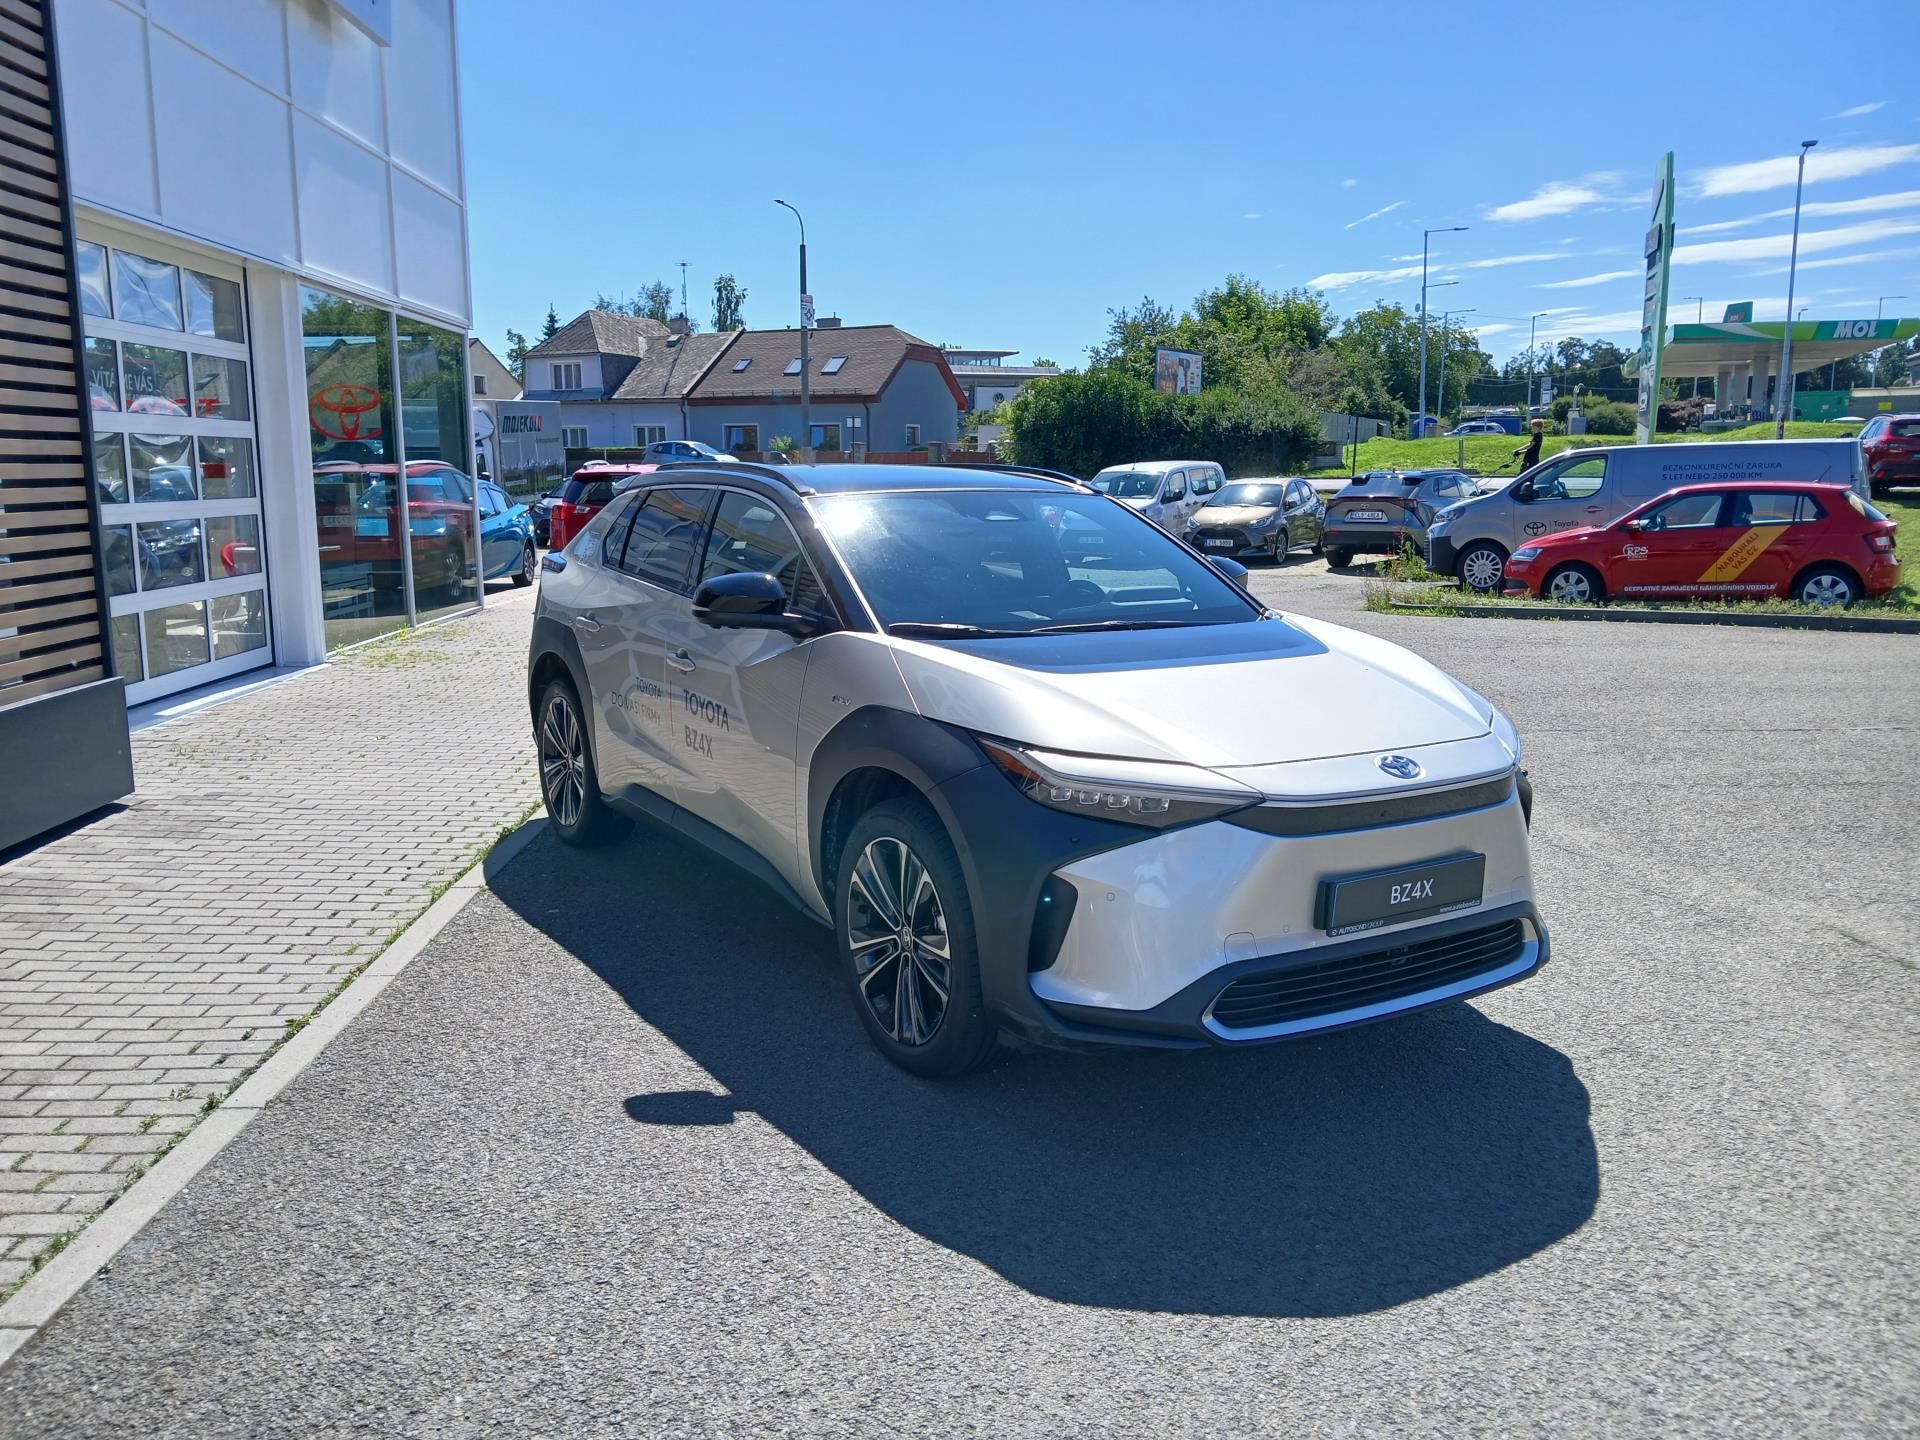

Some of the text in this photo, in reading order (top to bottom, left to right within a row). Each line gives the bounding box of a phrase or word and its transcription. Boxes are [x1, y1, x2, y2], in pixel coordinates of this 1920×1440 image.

[1833, 321, 1878, 338] MOL
[1685, 472, 1710, 480] NEBO
[1748, 471, 1762, 479] KM
[1553, 520, 1579, 528] Toyota
[1625, 545, 1648, 555] RPS
[636, 677, 661, 697] TOYOTA
[611, 692, 624, 707] DO
[683, 689, 729, 732] TOYOTA
[685, 725, 713, 760] BZ4X
[1391, 879, 1434, 904] BZ4X
[1440, 899, 1480, 913] www.autobond.cz
[1338, 923, 1367, 935] AUTOBOND
